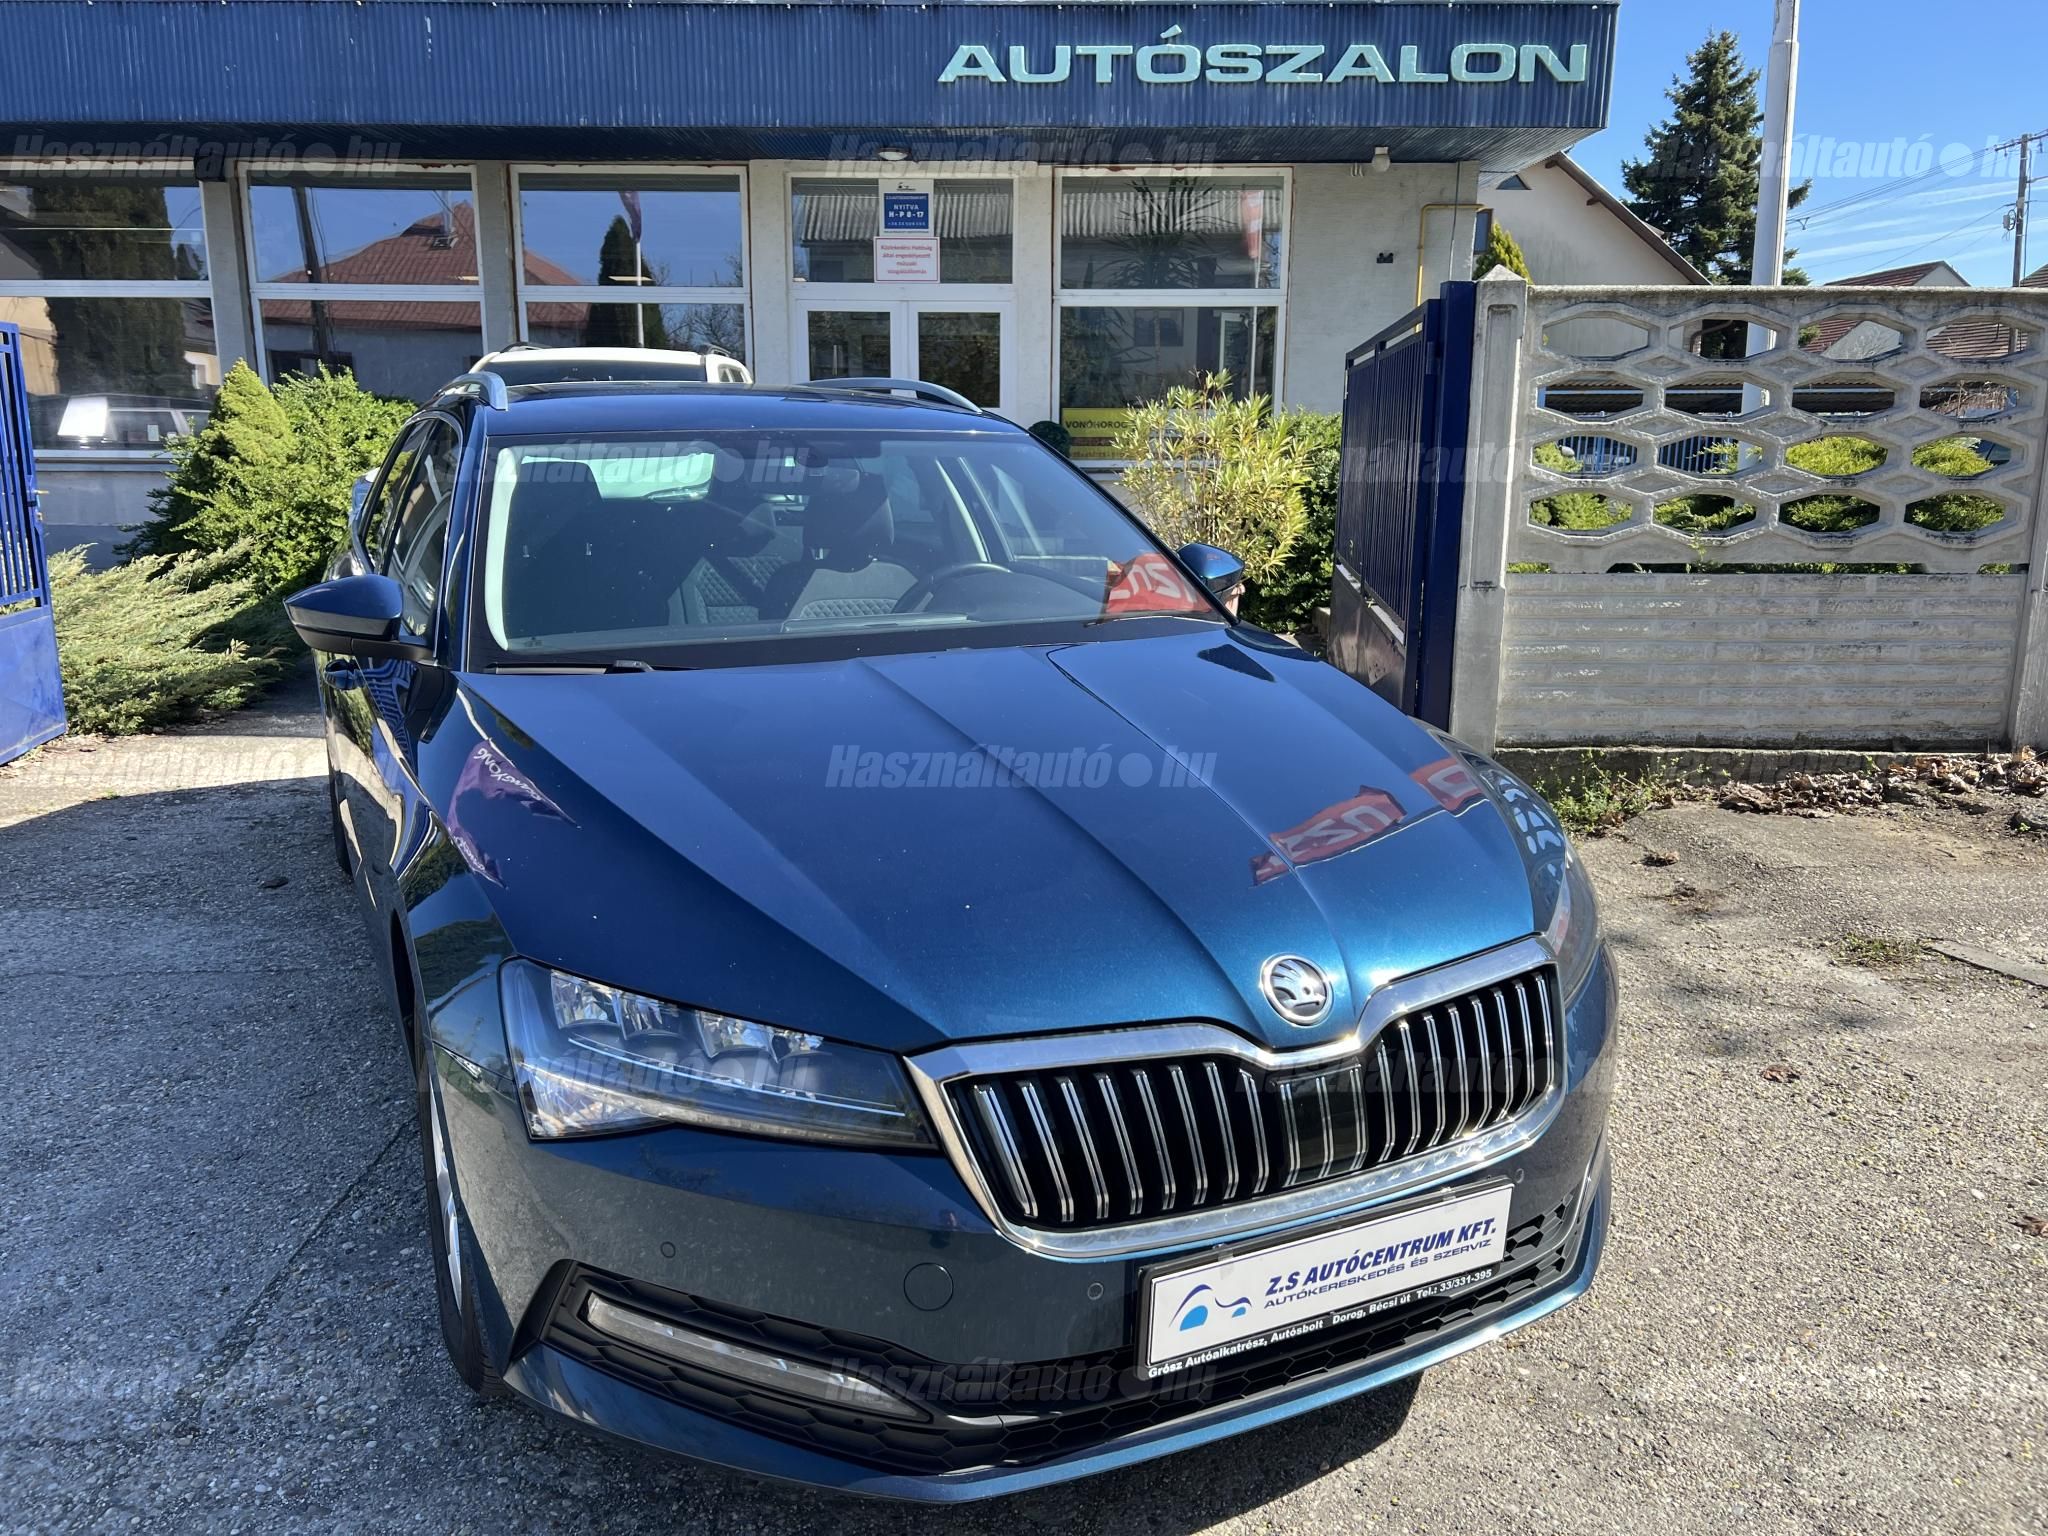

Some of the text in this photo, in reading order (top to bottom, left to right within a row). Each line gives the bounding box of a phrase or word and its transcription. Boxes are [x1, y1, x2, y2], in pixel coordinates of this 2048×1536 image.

[938, 24, 1587, 83] AUTÓSZALON
[1264, 1239, 1492, 1309] AUTÓKERESKEDÉS ÉS SZERVIZ
[1265, 1217, 1497, 1297] Z.S AUTÓCENTRUM KFT.
[1148, 1269, 1492, 1379] Grósz Autóalkatrész, Autósbolt Dorog, Bécsi út Tel.: 33/331-395
